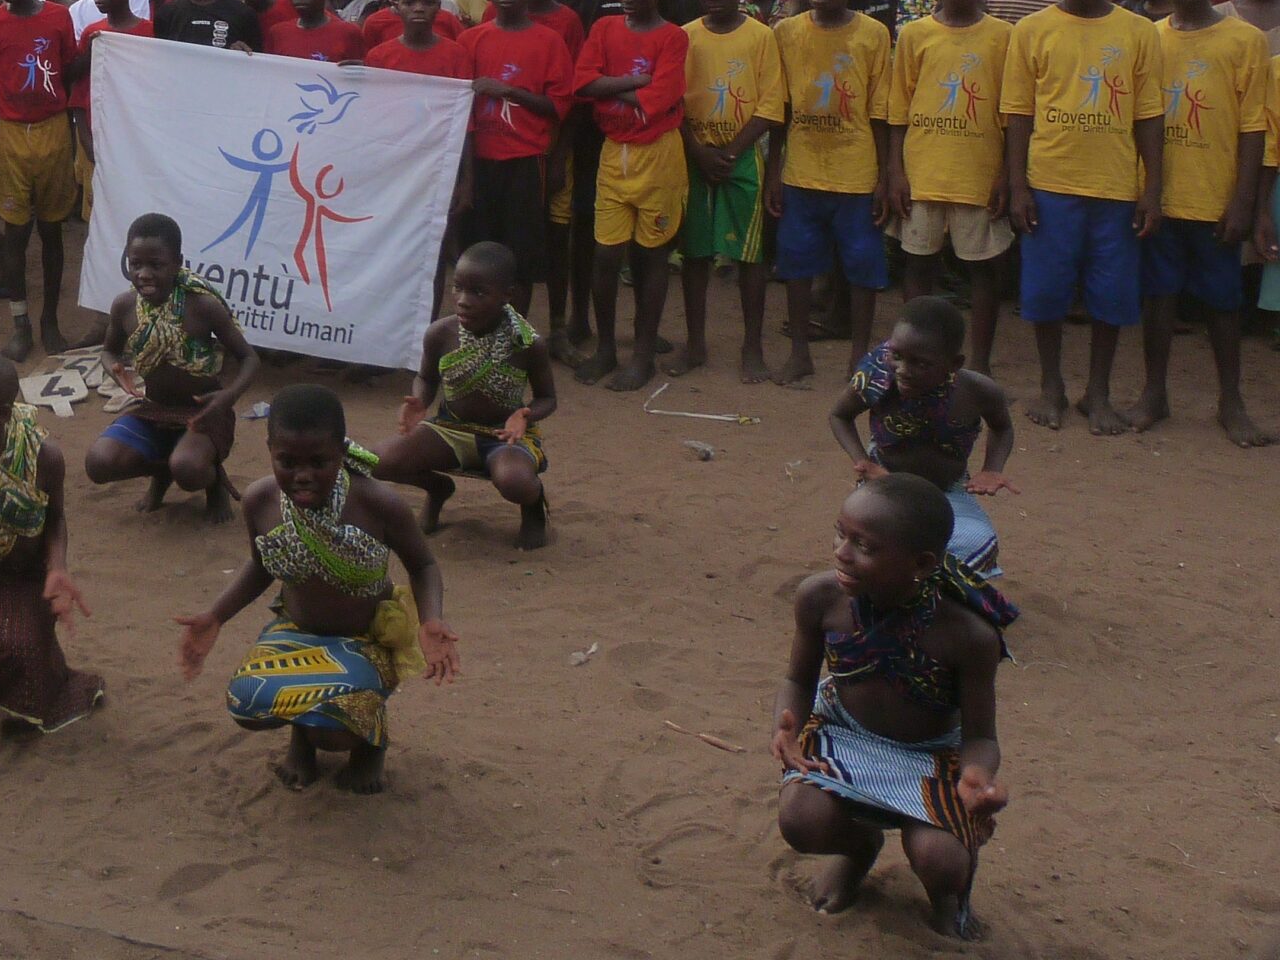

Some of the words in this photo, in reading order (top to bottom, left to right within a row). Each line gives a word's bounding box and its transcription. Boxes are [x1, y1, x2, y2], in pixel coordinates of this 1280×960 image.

[229, 303, 276, 332] iritti
[282, 312, 355, 345] Umani
[40, 375, 76, 398] 4
